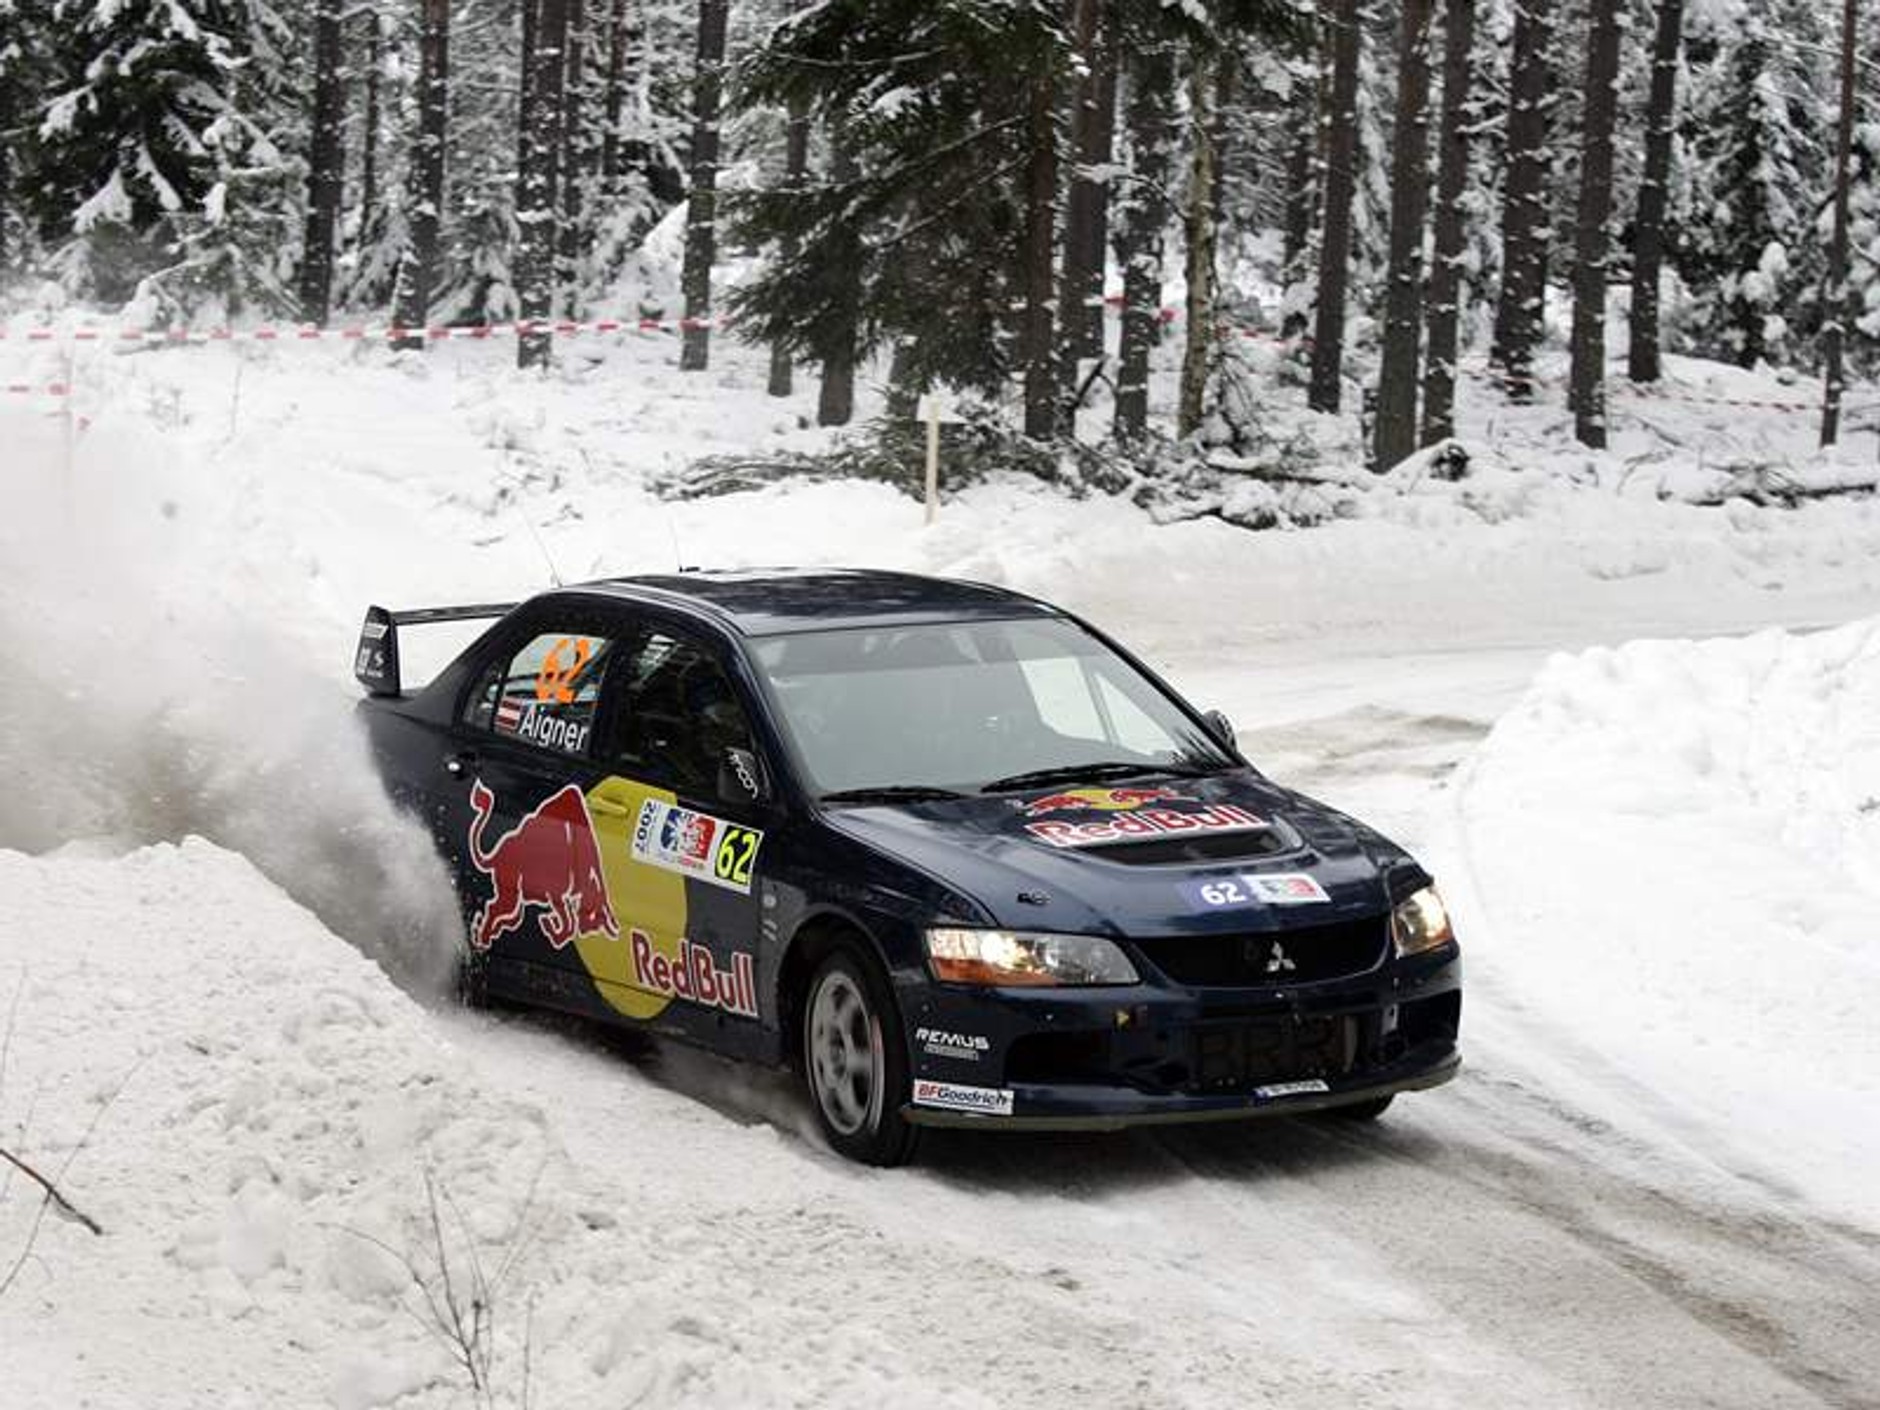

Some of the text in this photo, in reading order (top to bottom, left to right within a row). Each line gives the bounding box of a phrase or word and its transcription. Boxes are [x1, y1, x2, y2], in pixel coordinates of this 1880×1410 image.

[535, 638, 589, 703] 62
[517, 704, 589, 750] Aigner
[716, 829, 756, 884] 62
[1200, 881, 1247, 904] 62
[915, 1027, 990, 1050] REMUS
[917, 1083, 1008, 1106] BFGoodrich
